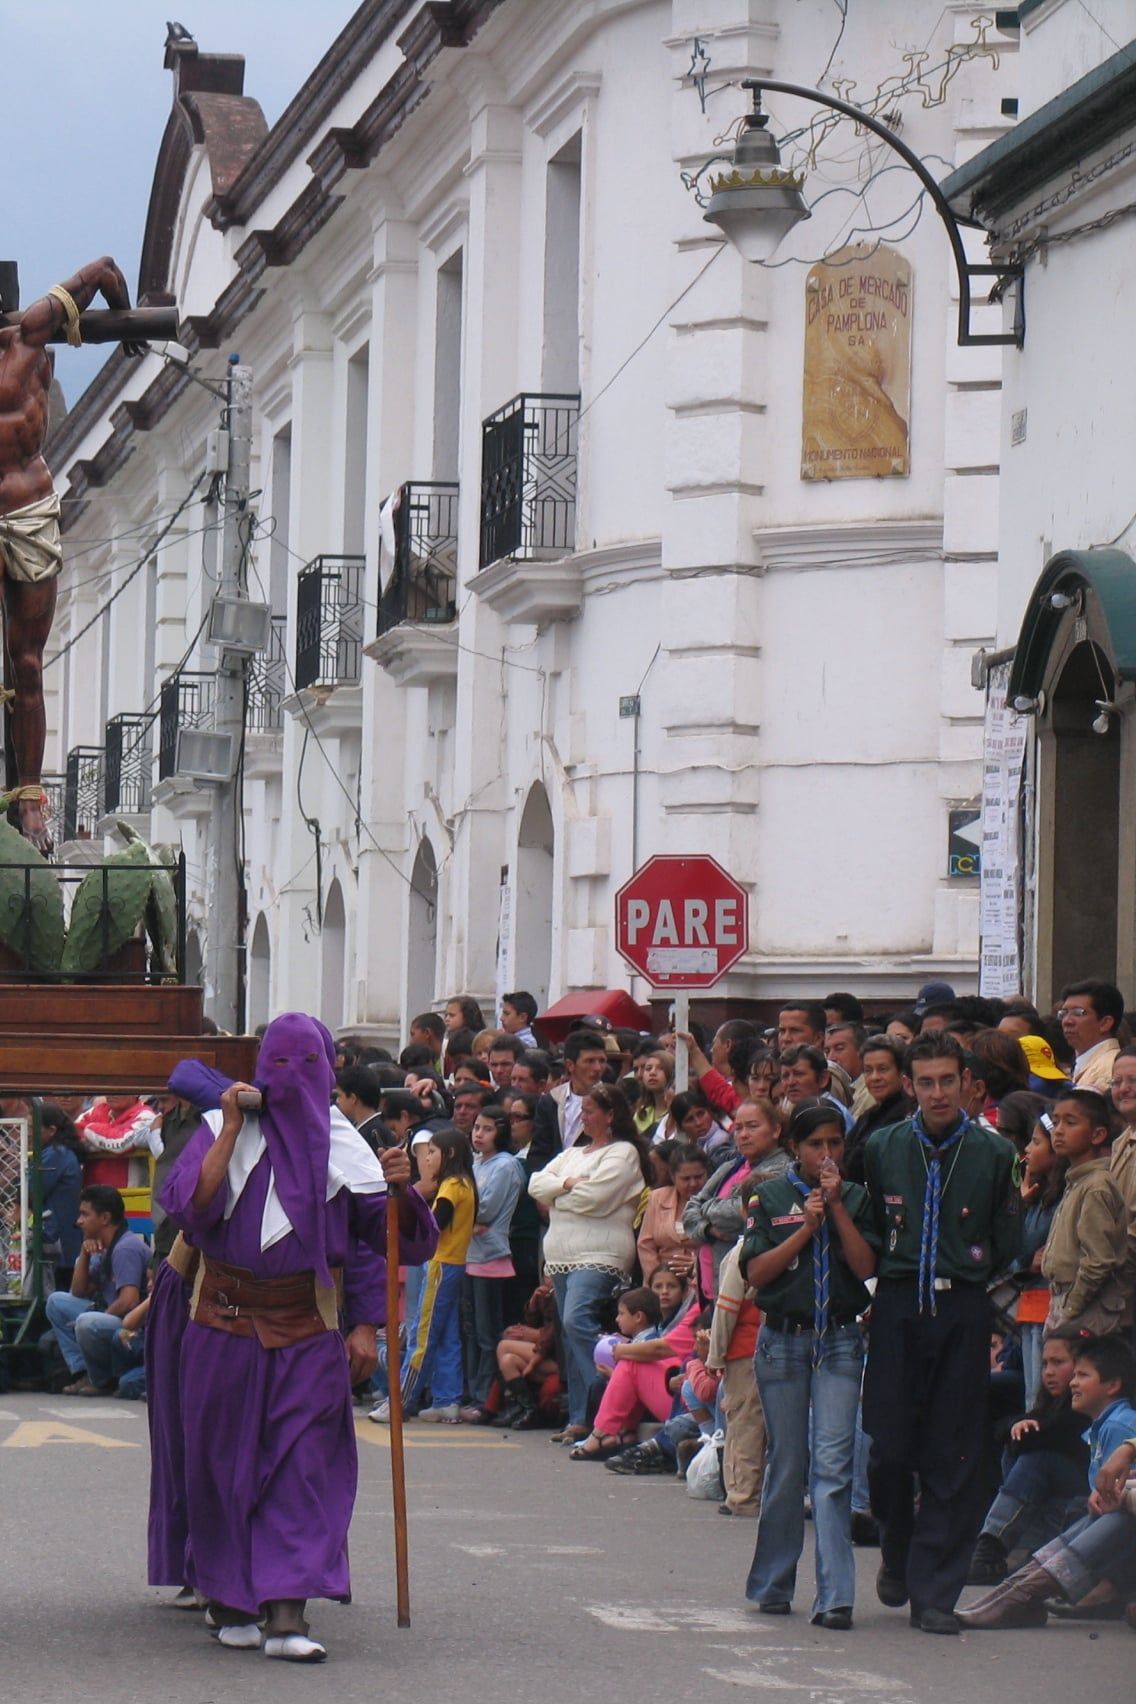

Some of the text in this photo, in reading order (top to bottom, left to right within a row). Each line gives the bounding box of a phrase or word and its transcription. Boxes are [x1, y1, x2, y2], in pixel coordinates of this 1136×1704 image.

[808, 275, 908, 325] CASA DE MERCADO
[849, 298, 866, 309] DE
[827, 312, 888, 333] PAMPLONA
[627, 899, 737, 945] PARE
